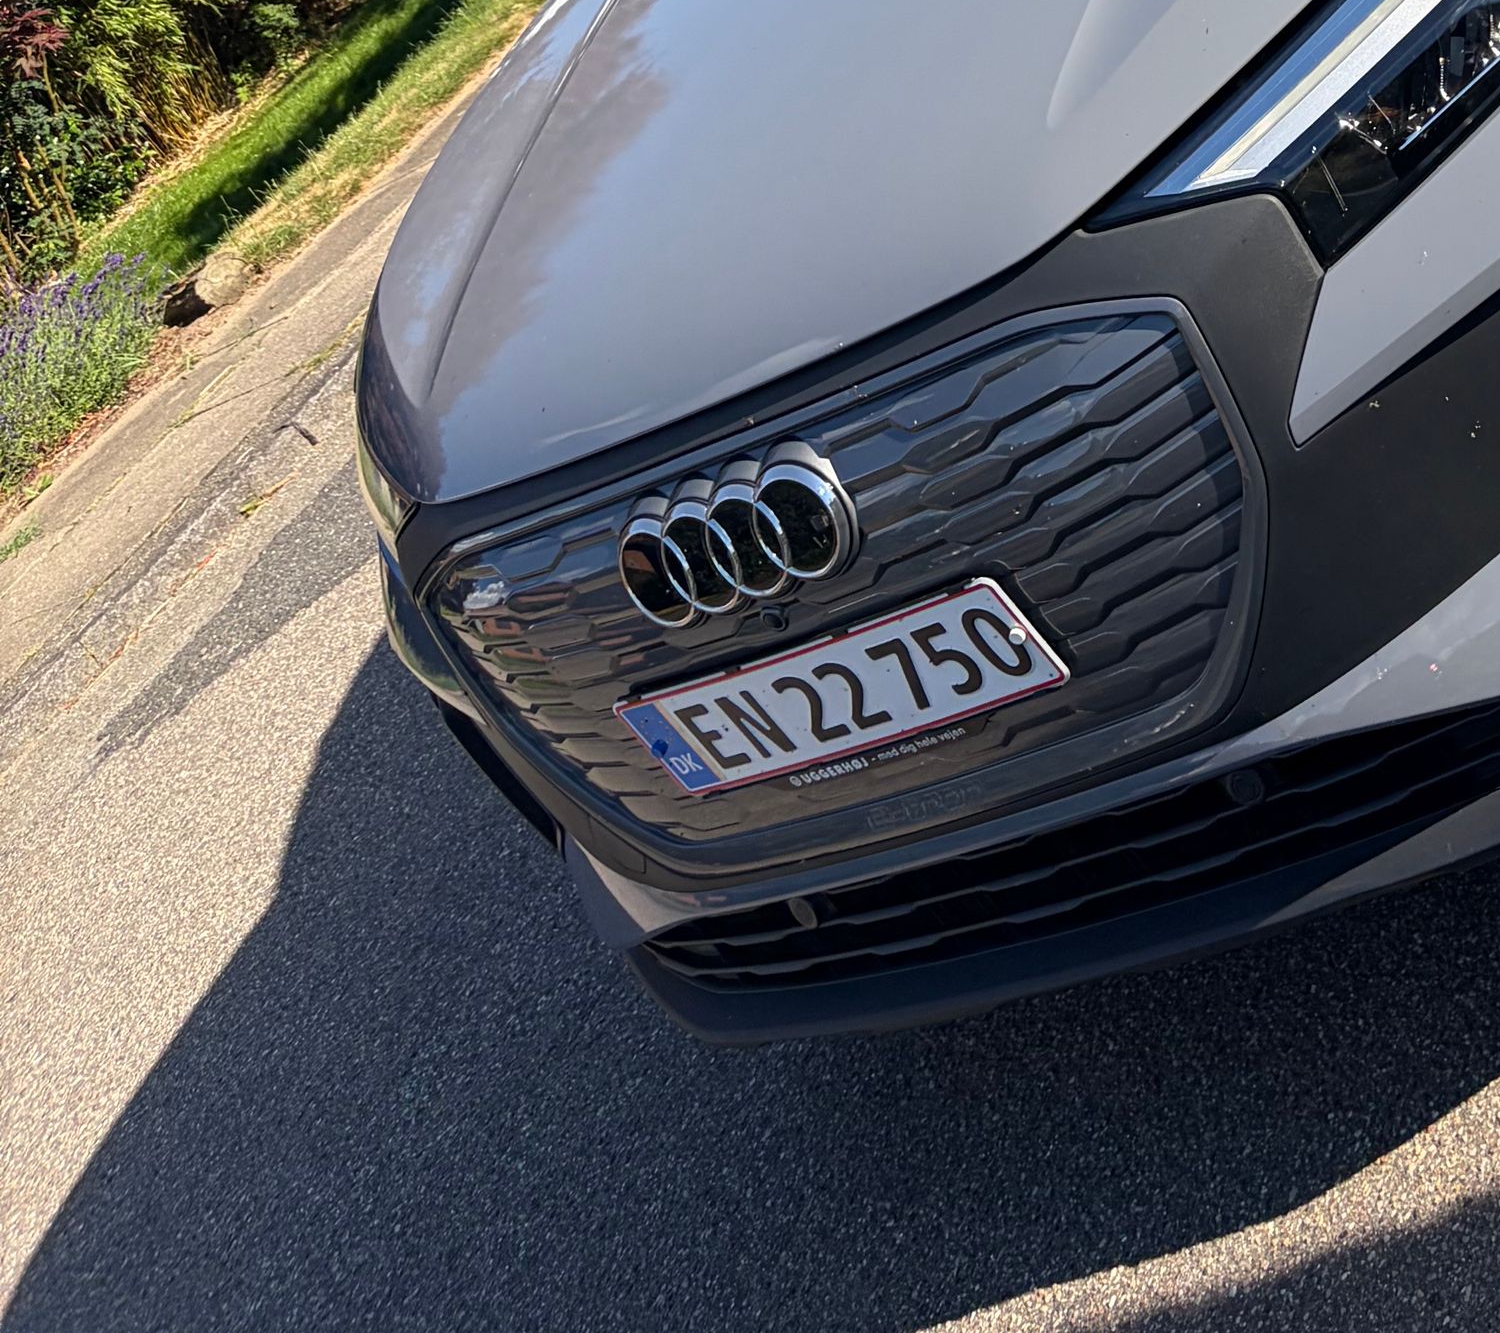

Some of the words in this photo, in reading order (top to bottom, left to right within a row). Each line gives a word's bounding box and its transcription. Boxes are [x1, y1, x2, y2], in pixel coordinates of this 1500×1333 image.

[674, 689, 798, 770] EN
[772, 662, 893, 743] 22
[865, 608, 1033, 710] 750
[669, 753, 703, 777] DK
[801, 756, 870, 784] UGGERHØJ
[899, 742, 919, 755] dig
[917, 735, 938, 749] hele
[937, 726, 967, 744] vejen
